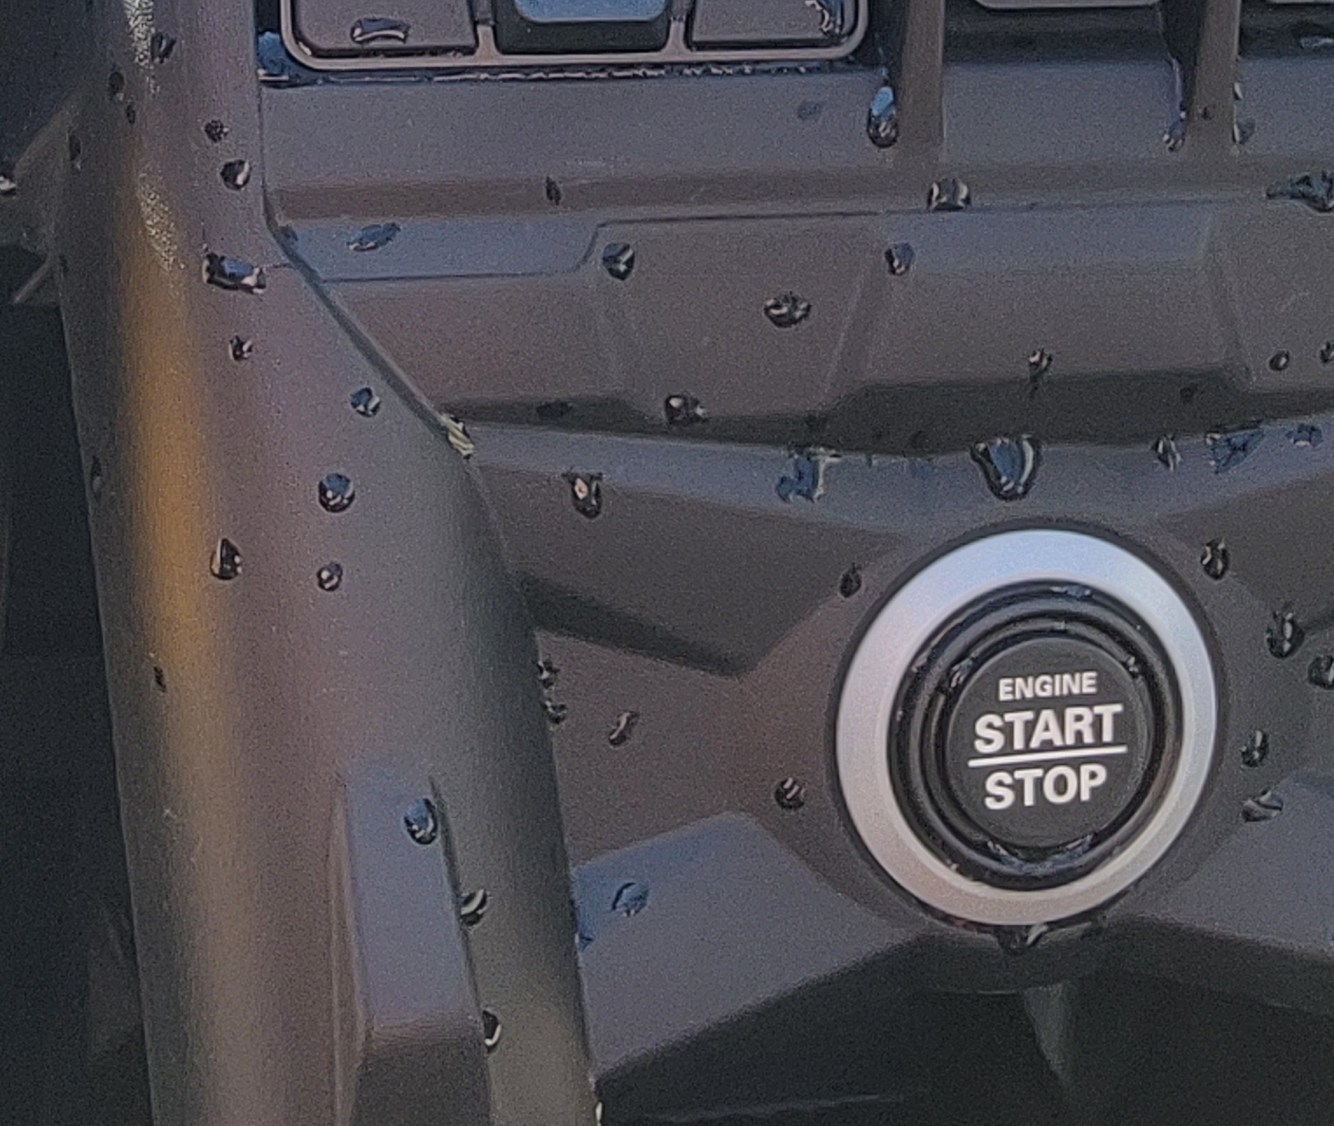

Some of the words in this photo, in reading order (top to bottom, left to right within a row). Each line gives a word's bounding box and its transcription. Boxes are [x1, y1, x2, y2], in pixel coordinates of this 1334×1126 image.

[998, 671, 1098, 702] ENGINE
[973, 703, 1123, 754] START
[984, 764, 1107, 810] STOP
